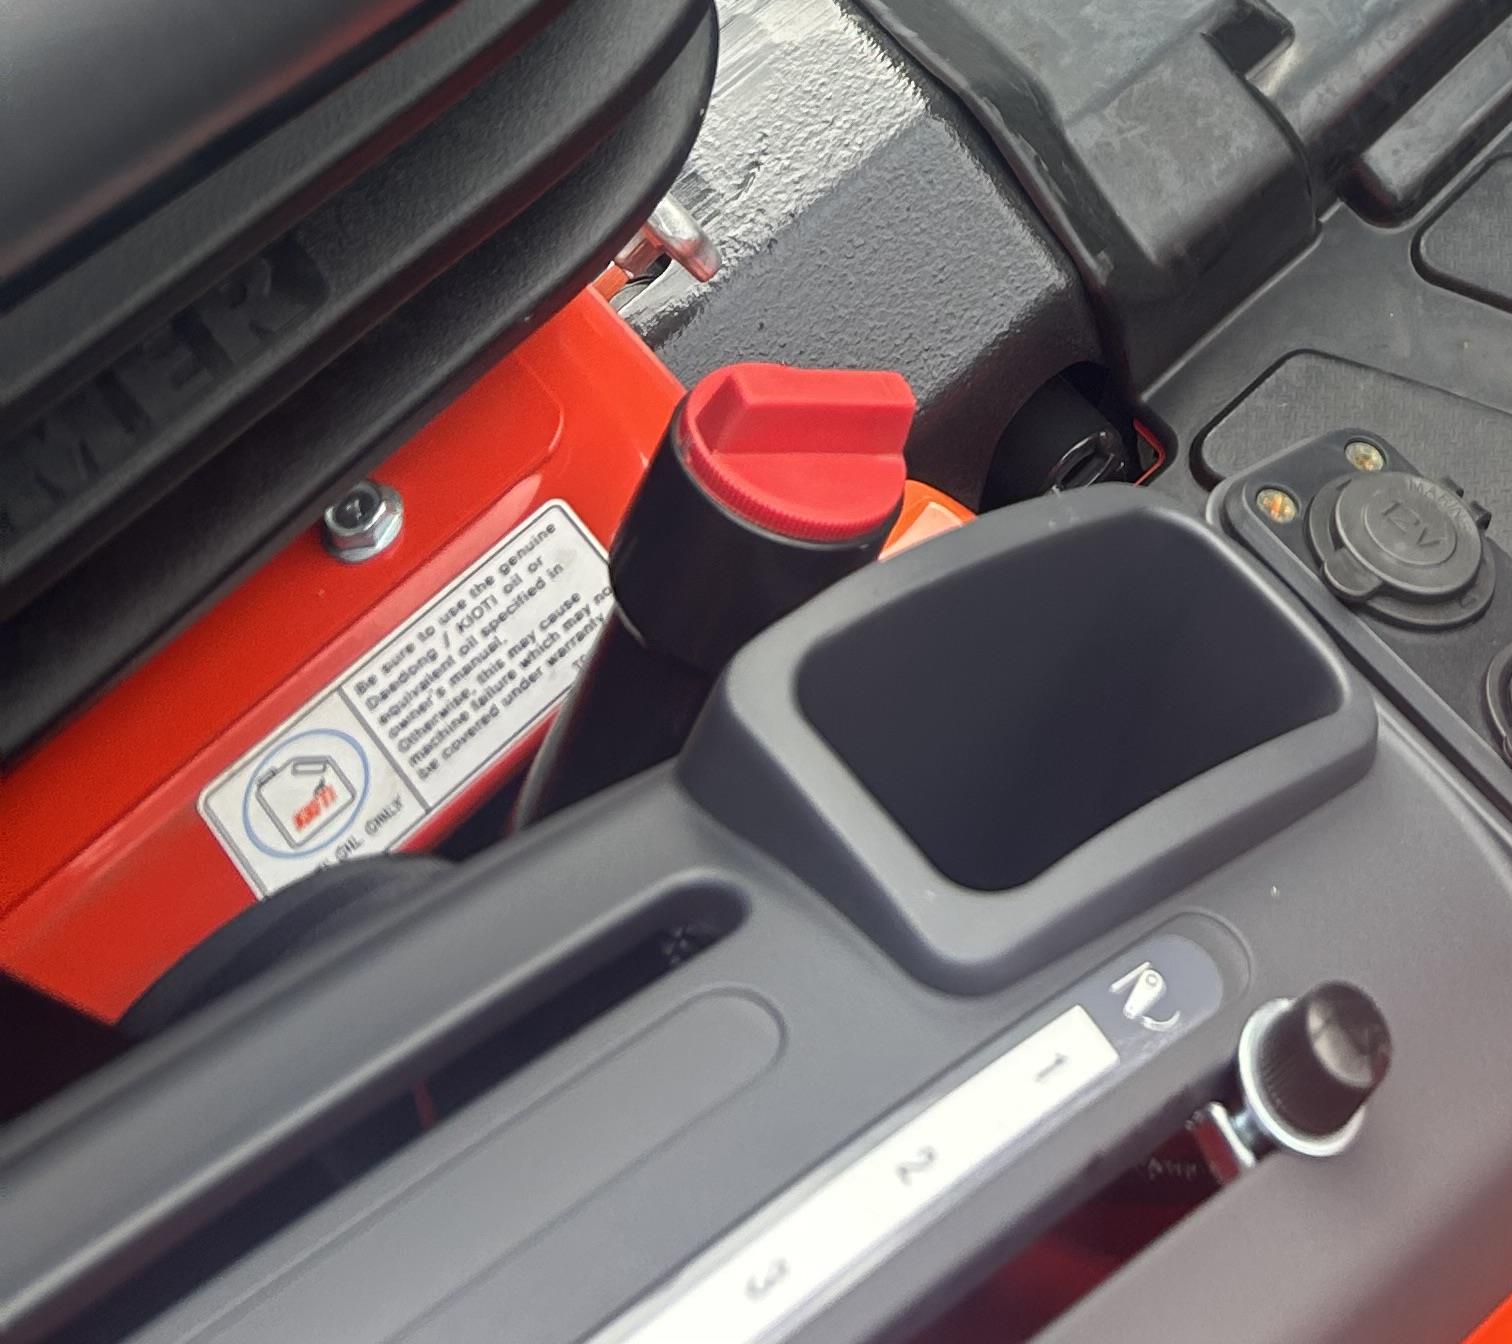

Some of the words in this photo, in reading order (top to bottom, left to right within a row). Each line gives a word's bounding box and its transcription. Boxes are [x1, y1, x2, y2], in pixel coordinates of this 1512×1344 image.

[1381, 500, 1442, 548] 12V
[353, 674, 378, 697] Be
[381, 642, 416, 675] sure
[417, 624, 436, 643] to
[438, 599, 468, 625] use
[469, 575, 496, 599] the
[498, 523, 556, 576] genuine
[364, 648, 439, 711] Daedong
[456, 594, 499, 633] KIOTI
[503, 573, 523, 595] oil
[527, 555, 544, 574] or
[458, 635, 478, 658] oil
[480, 576, 546, 638] specified
[546, 562, 564, 581] in
[475, 659, 506, 685] this
[506, 630, 537, 660] may
[538, 592, 582, 631] cause
[408, 710, 470, 768] machine
[469, 669, 517, 711] failure
[519, 630, 561, 668] which
[562, 604, 591, 632] may
[441, 704, 500, 761] covered
[501, 666, 544, 708] under
[364, 794, 405, 836] ONLY
[1033, 1052, 1068, 1083] 1
[895, 1145, 938, 1186] 2
[745, 1258, 790, 1301] 3
